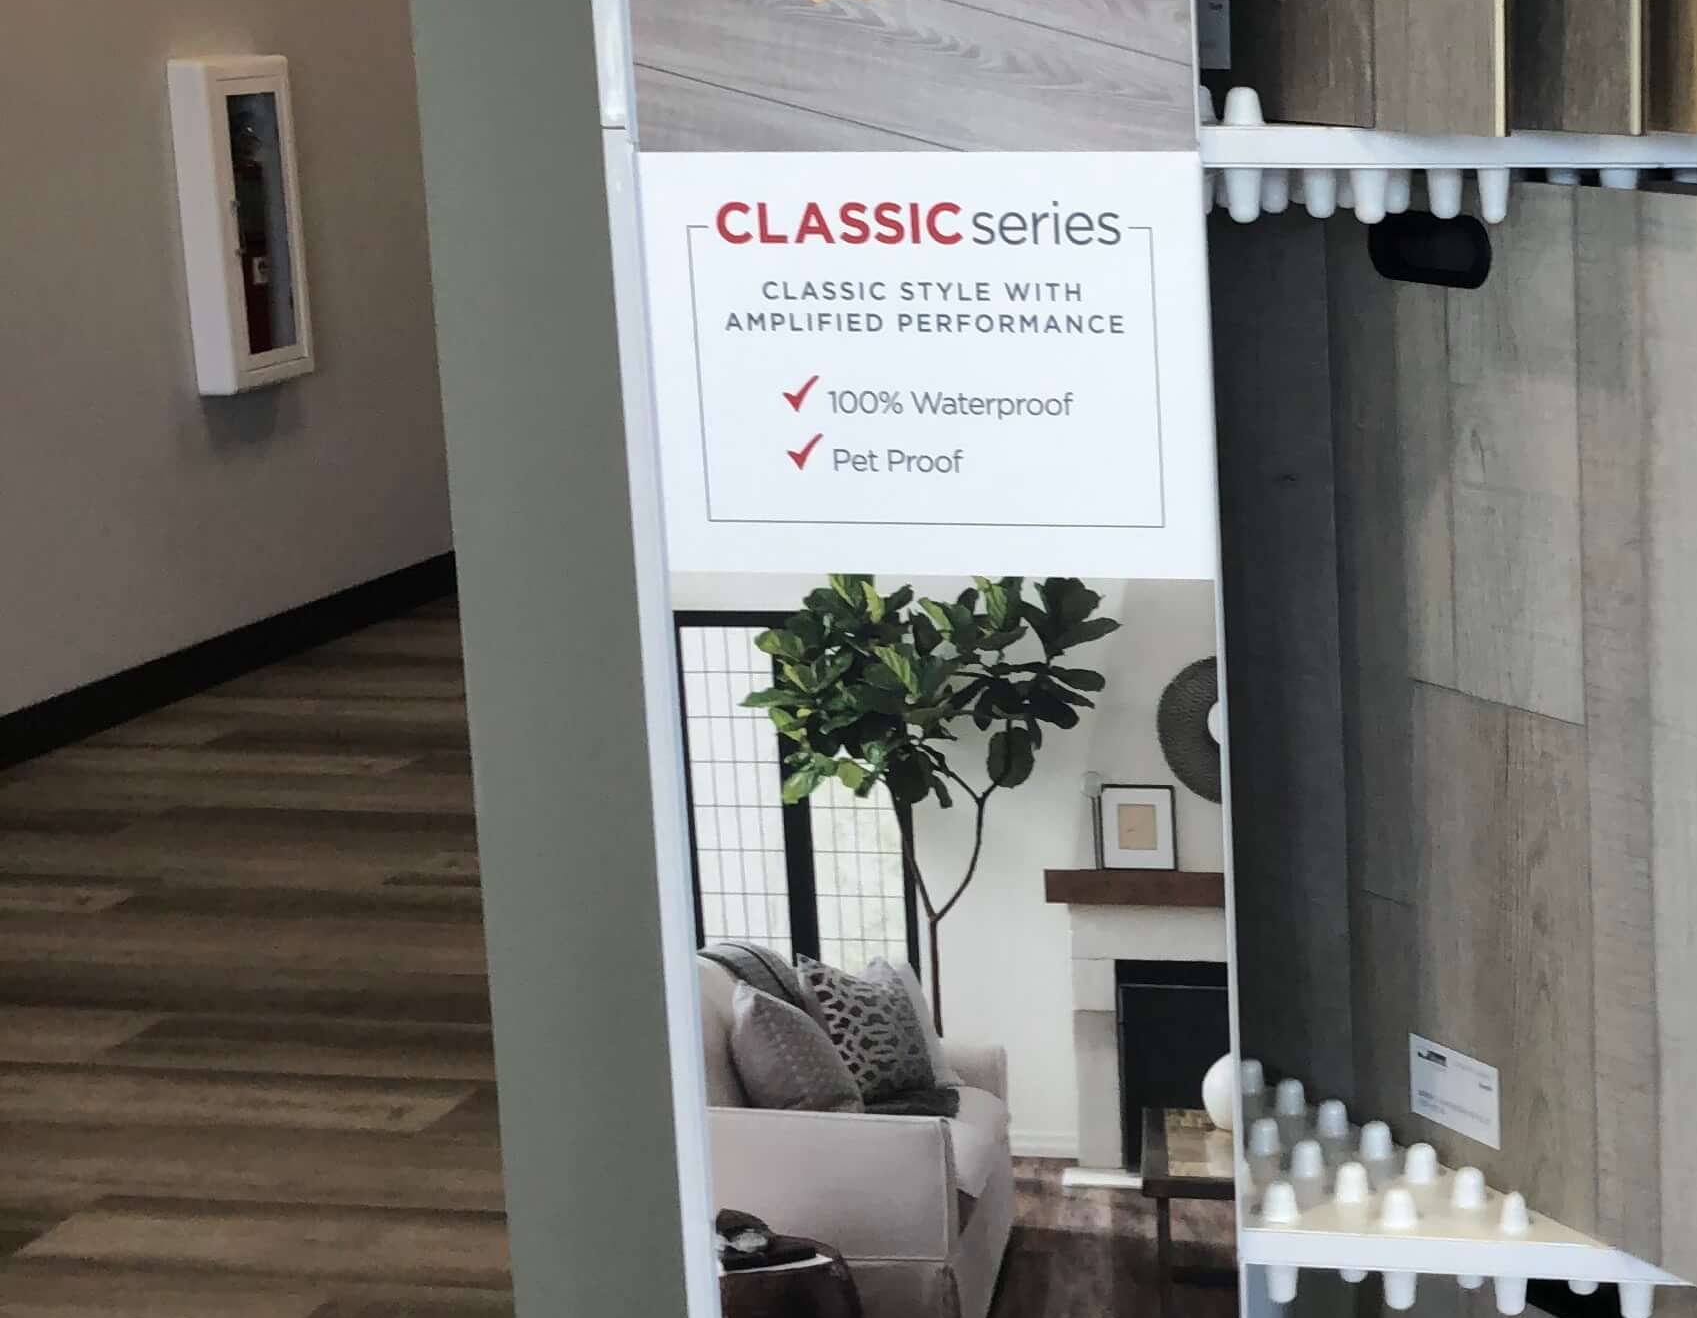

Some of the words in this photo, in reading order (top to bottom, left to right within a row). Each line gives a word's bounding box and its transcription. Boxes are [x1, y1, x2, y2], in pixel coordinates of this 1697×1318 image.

[716, 201, 963, 245] CLASSIC
[973, 201, 1122, 245] series
[762, 281, 887, 301] CLASSIC
[900, 281, 990, 301] STYLE
[1005, 282, 1082, 302] WITH
[726, 314, 883, 332] AMPLIFIED
[898, 315, 1125, 334] PERFORMANCE
[829, 390, 903, 415] 100%
[911, 390, 1073, 419] Waterproof
[833, 450, 879, 472] Pet
[888, 449, 963, 473] Proof
